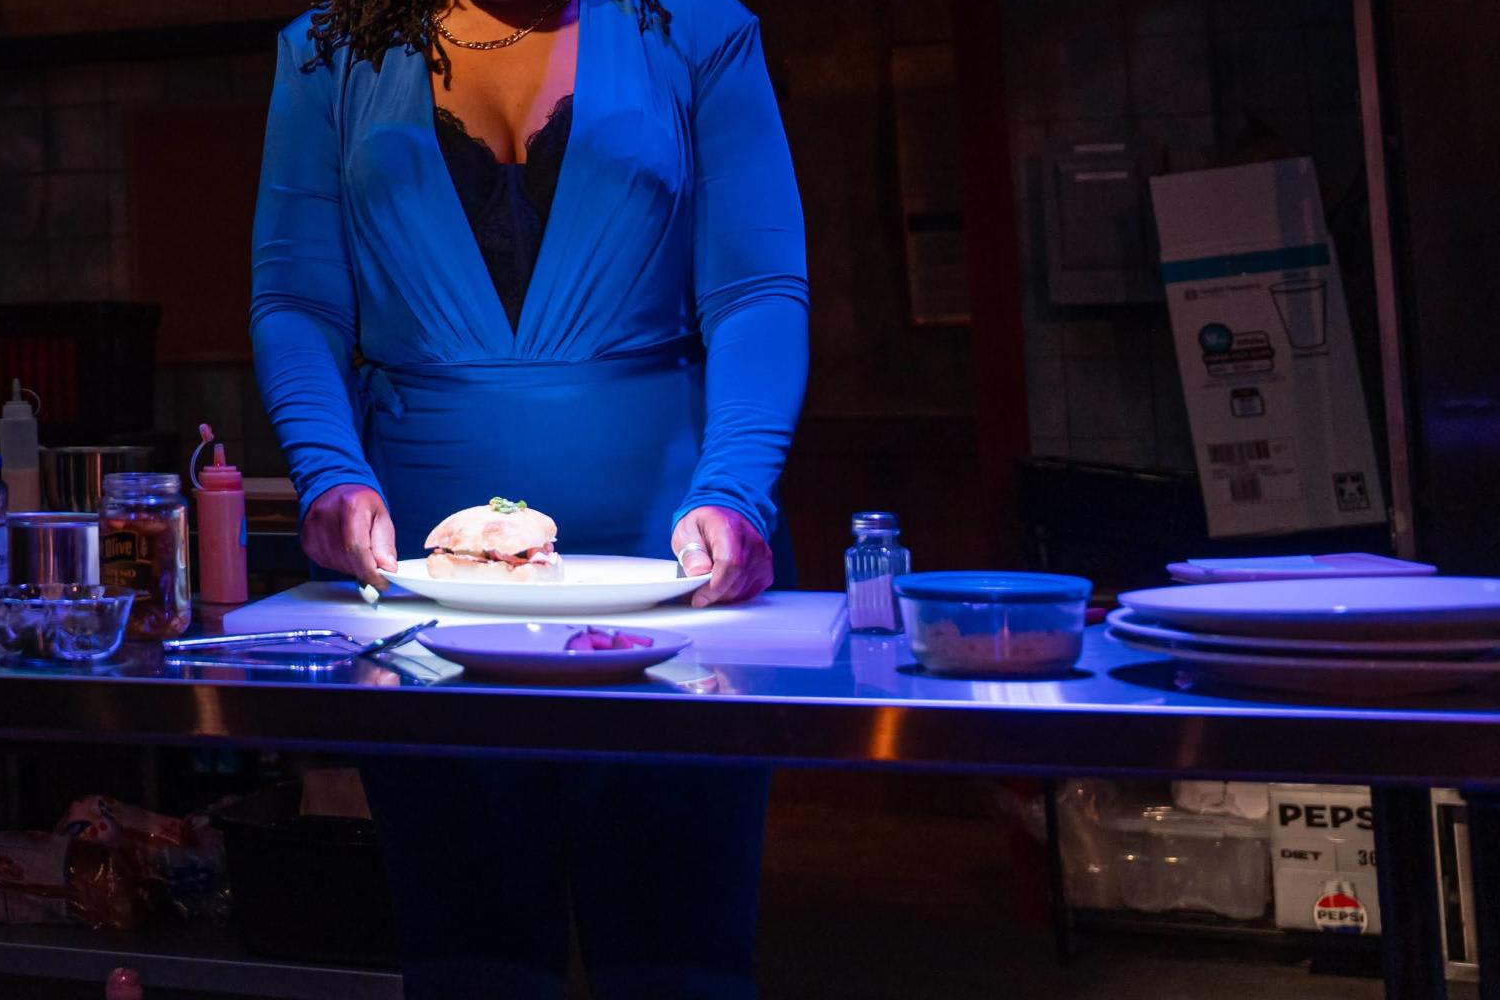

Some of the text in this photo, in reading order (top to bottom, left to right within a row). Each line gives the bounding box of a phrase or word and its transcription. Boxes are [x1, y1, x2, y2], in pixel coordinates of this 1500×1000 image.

[1279, 803, 1374, 830] PEPS
[1281, 849, 1322, 861] DIET
[1317, 910, 1364, 922] PEPSI
